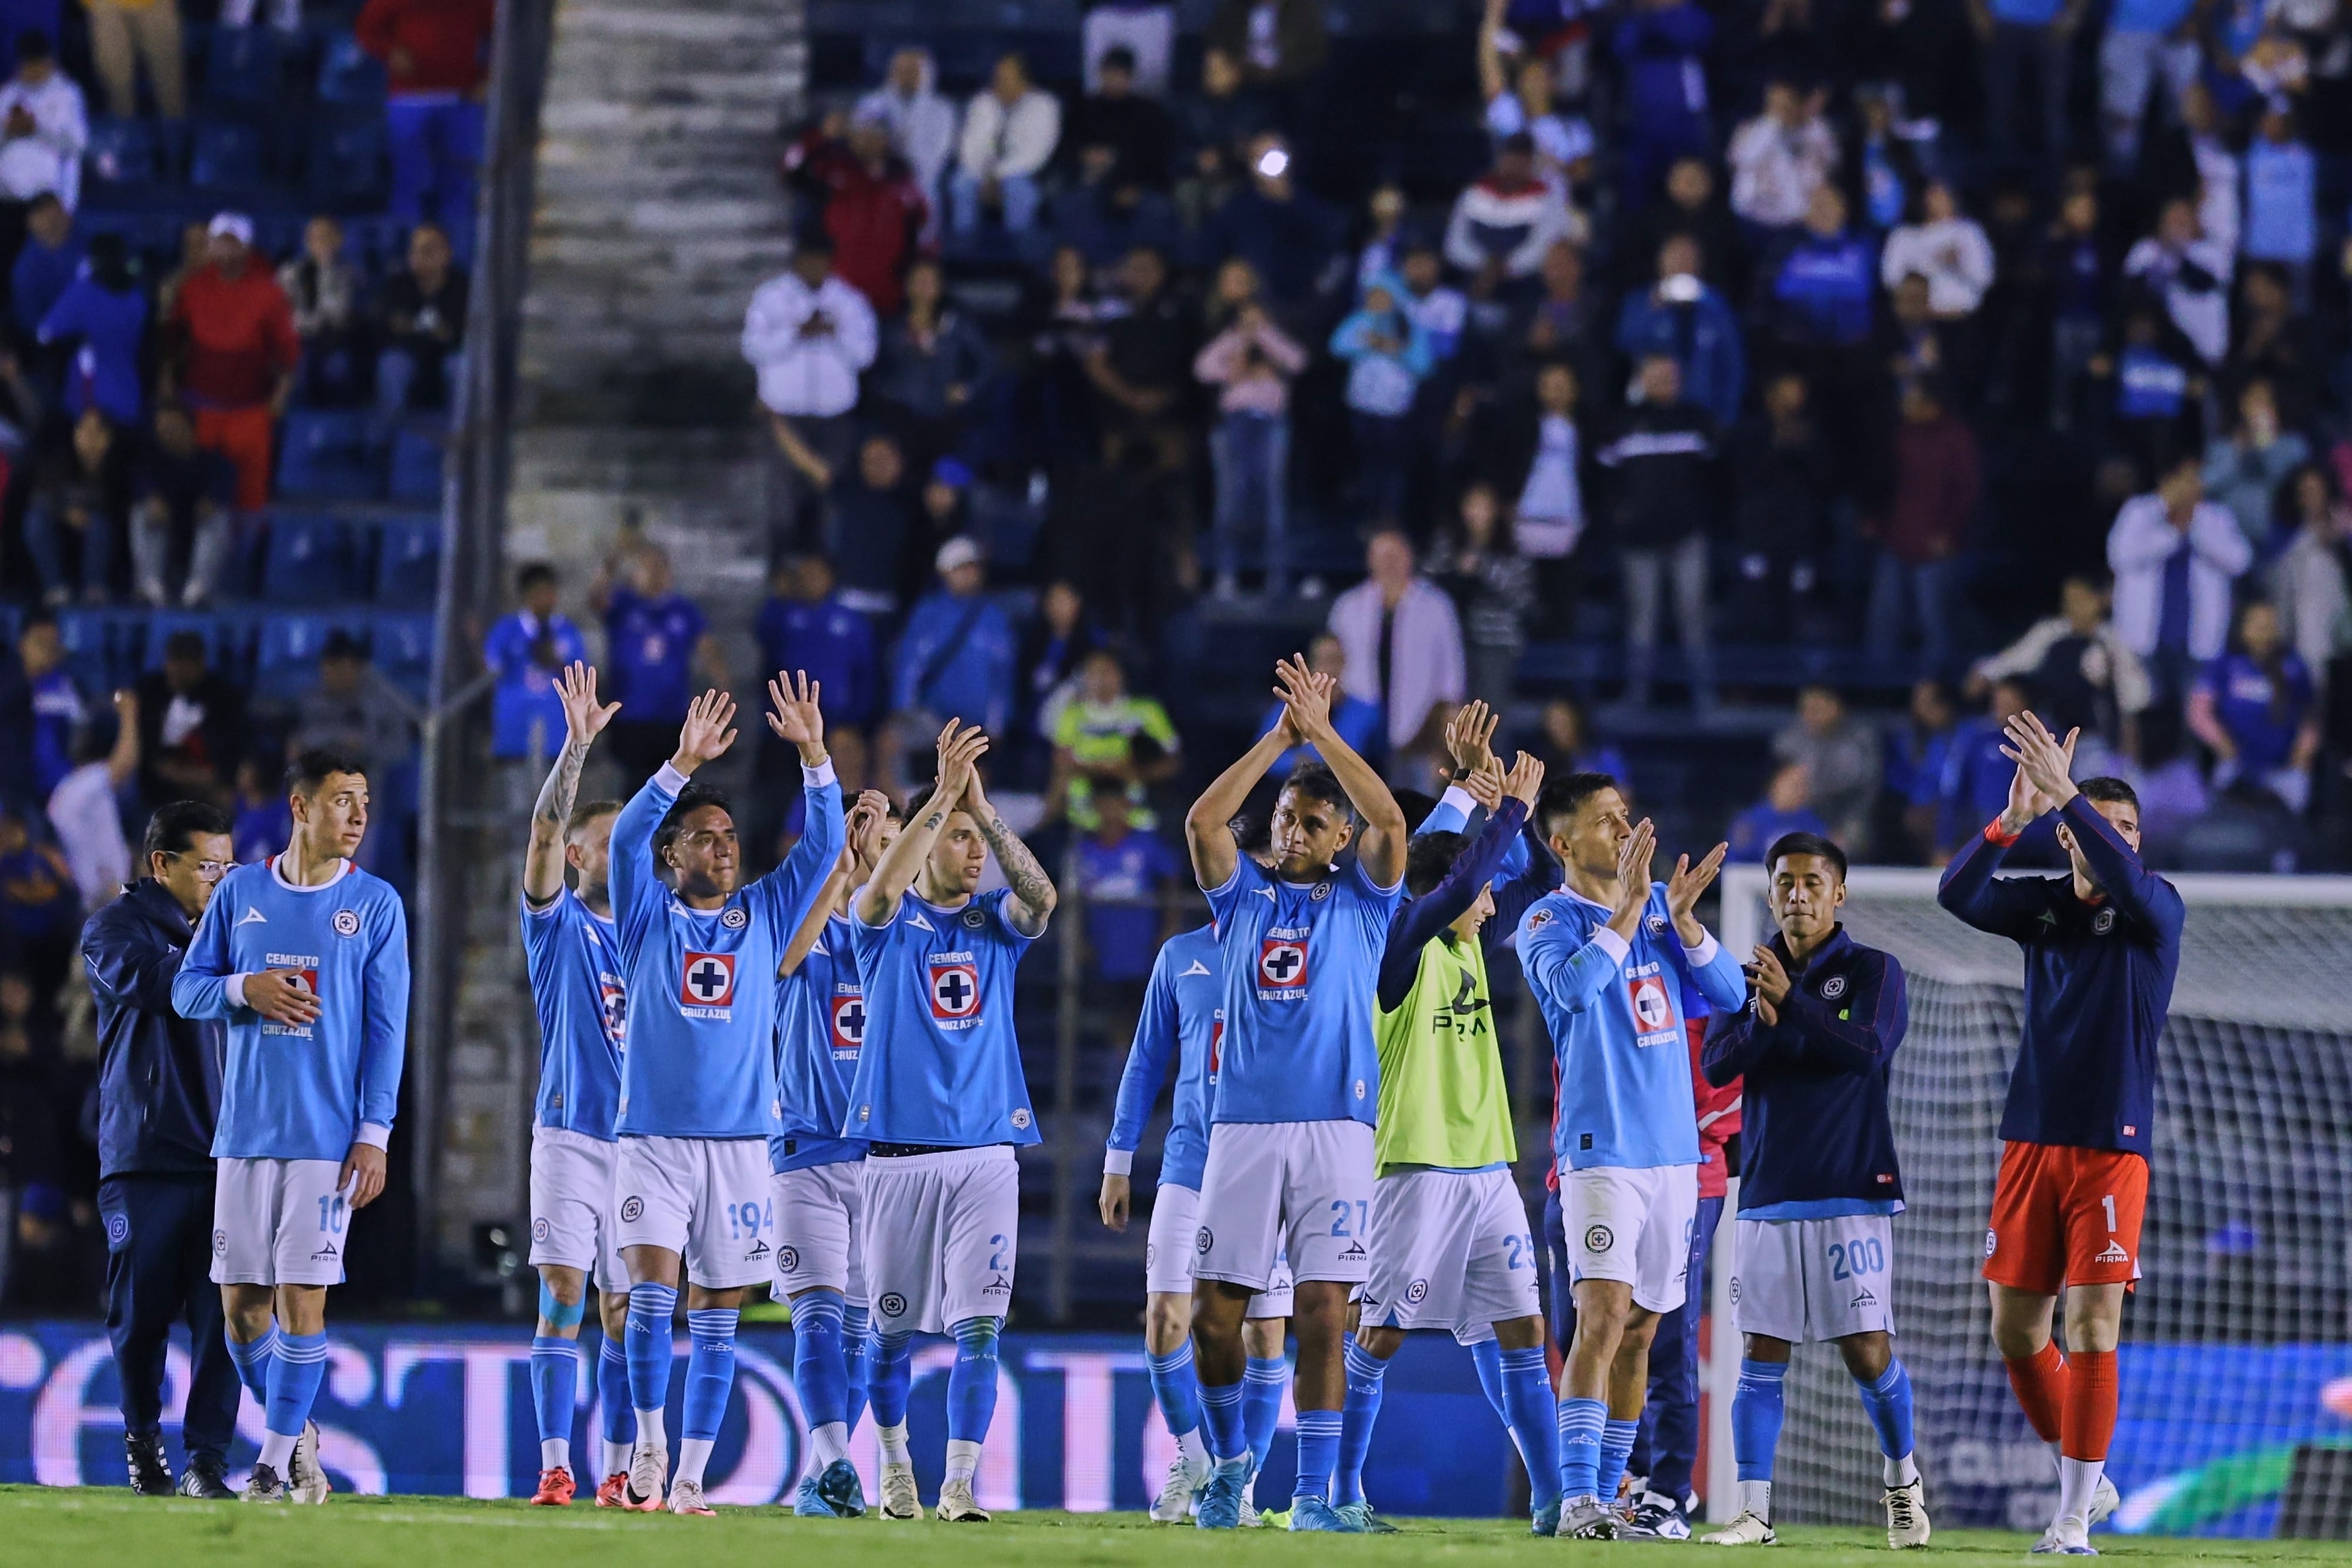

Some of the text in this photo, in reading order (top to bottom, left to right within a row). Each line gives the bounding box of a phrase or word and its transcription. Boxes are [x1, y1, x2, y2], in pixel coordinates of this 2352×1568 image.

[266, 952, 319, 967] CEMENTO
[1258, 988, 1308, 1001] CRUZ AZUL
[680, 1007, 732, 1020] CRUZ AZUL
[262, 1024, 313, 1038] CRUZ AZUL
[832, 1050, 858, 1061] CRUZ
[318, 1195, 345, 1234] 10
[727, 1196, 773, 1240] 194
[1331, 1199, 1368, 1237] 27
[2102, 1195, 2116, 1232] 1
[990, 1233, 1008, 1271] 2
[1828, 1236, 1885, 1282] 200
[2095, 1255, 2129, 1263] PIRMA
[983, 1288, 1010, 1296] PIRM
[1850, 1299, 1877, 1309] PIRMA
